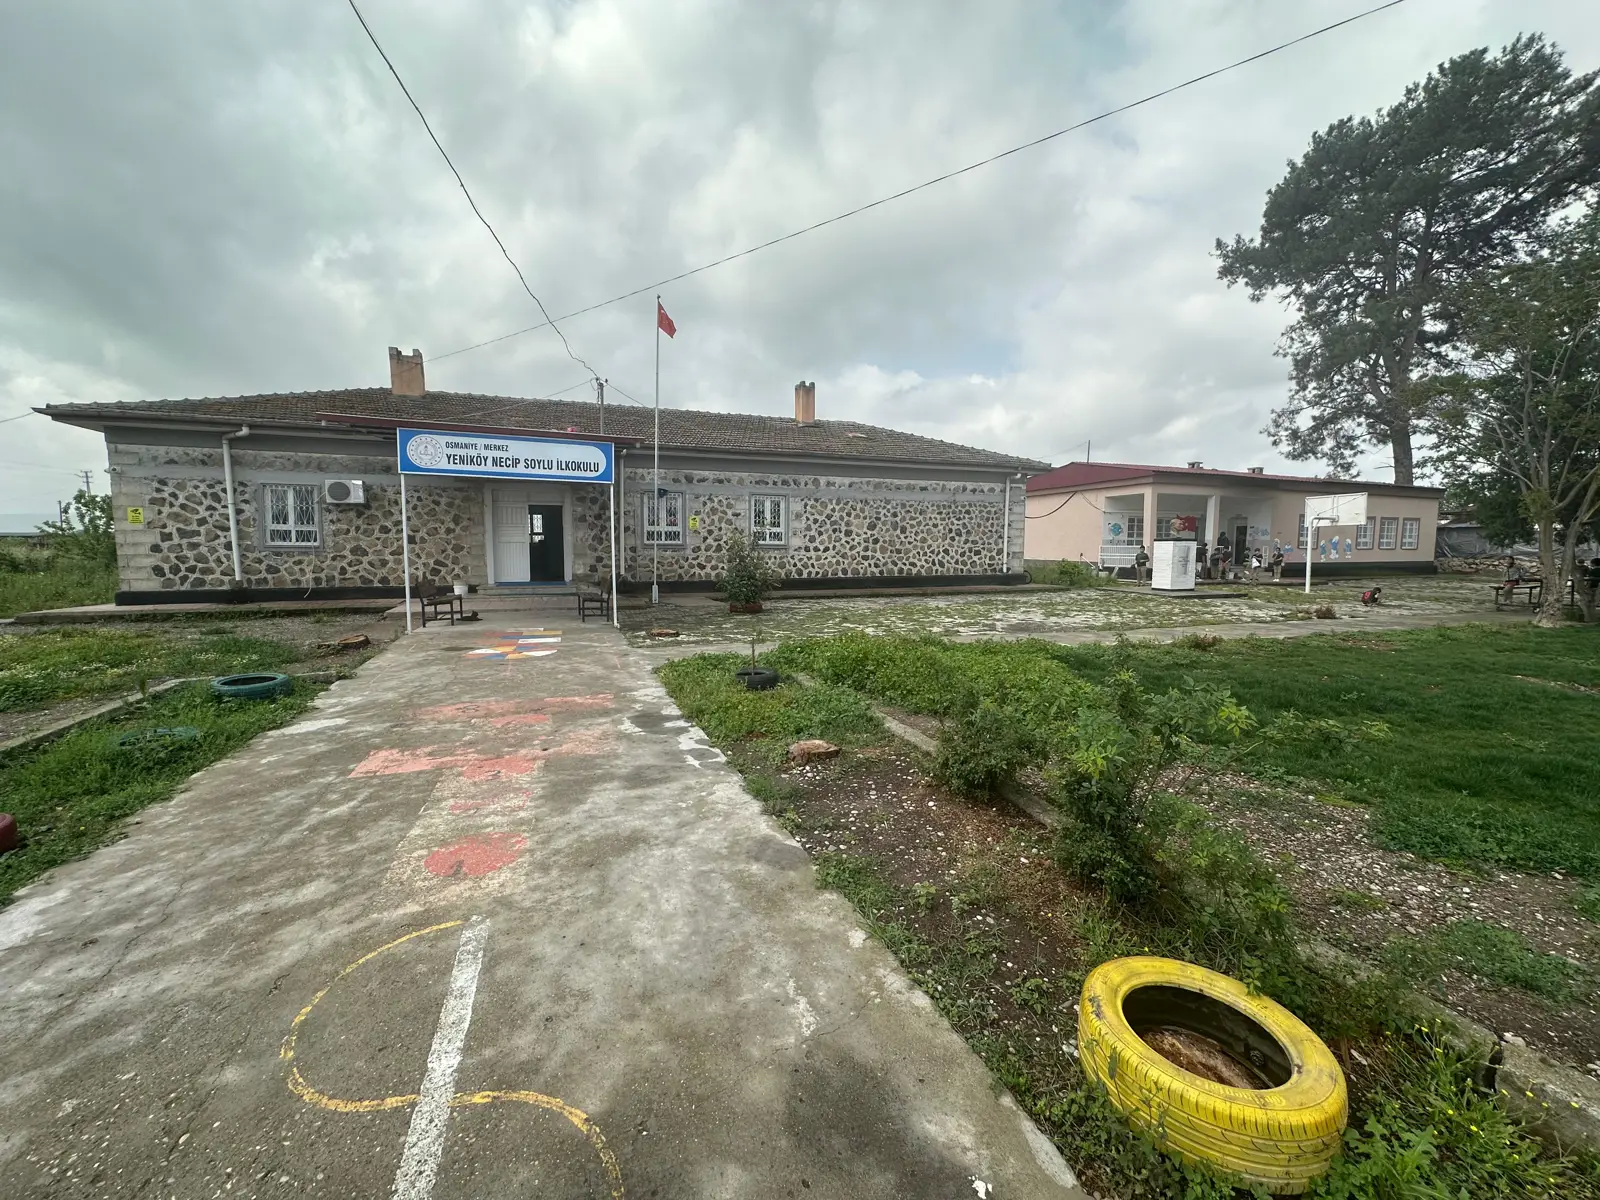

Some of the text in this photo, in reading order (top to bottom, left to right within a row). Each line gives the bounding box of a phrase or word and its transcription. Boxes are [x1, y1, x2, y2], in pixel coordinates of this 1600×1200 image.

[445, 441, 478, 450] OSMANİYE
[484, 444, 508, 452] MERKEZ
[446, 452, 600, 473] YENİKÖY NECİP SOYLU İLKOKULU
